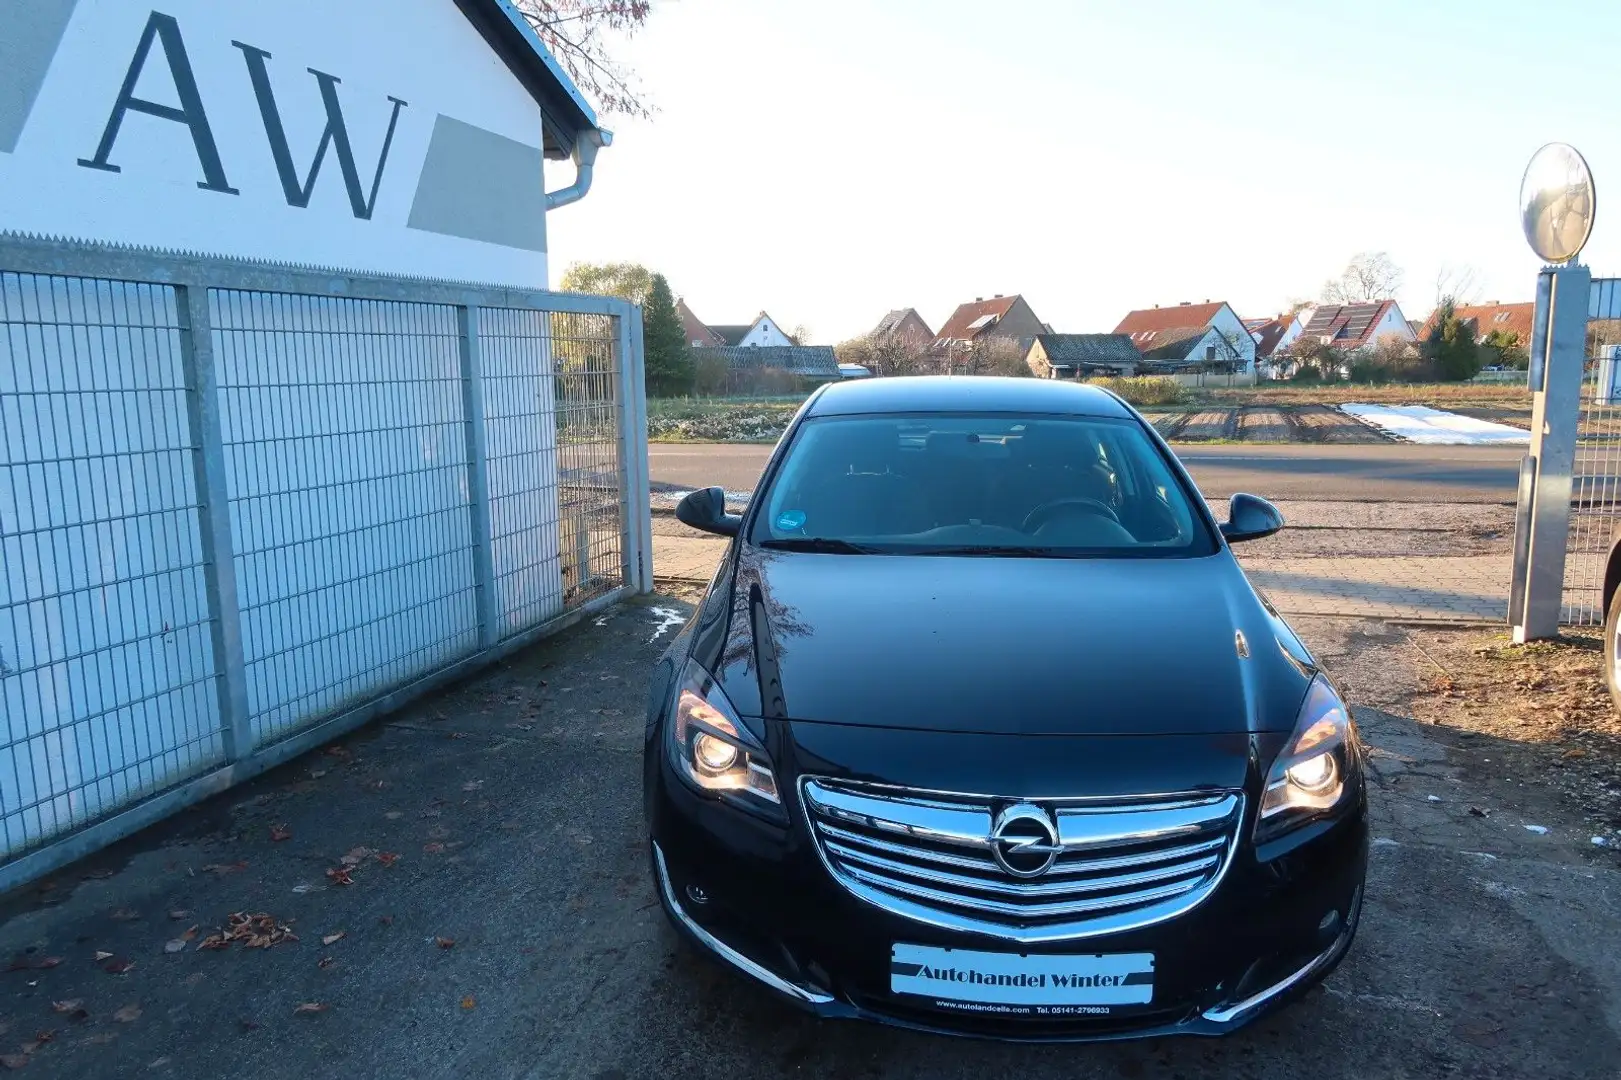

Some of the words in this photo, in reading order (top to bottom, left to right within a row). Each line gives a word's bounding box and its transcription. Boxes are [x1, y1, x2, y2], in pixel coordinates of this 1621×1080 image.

[77, 10, 408, 220] AW
[917, 964, 1046, 988] Autohandel
[1050, 973, 1123, 988] Winter
[1037, 1006, 1050, 1014] Tel.
